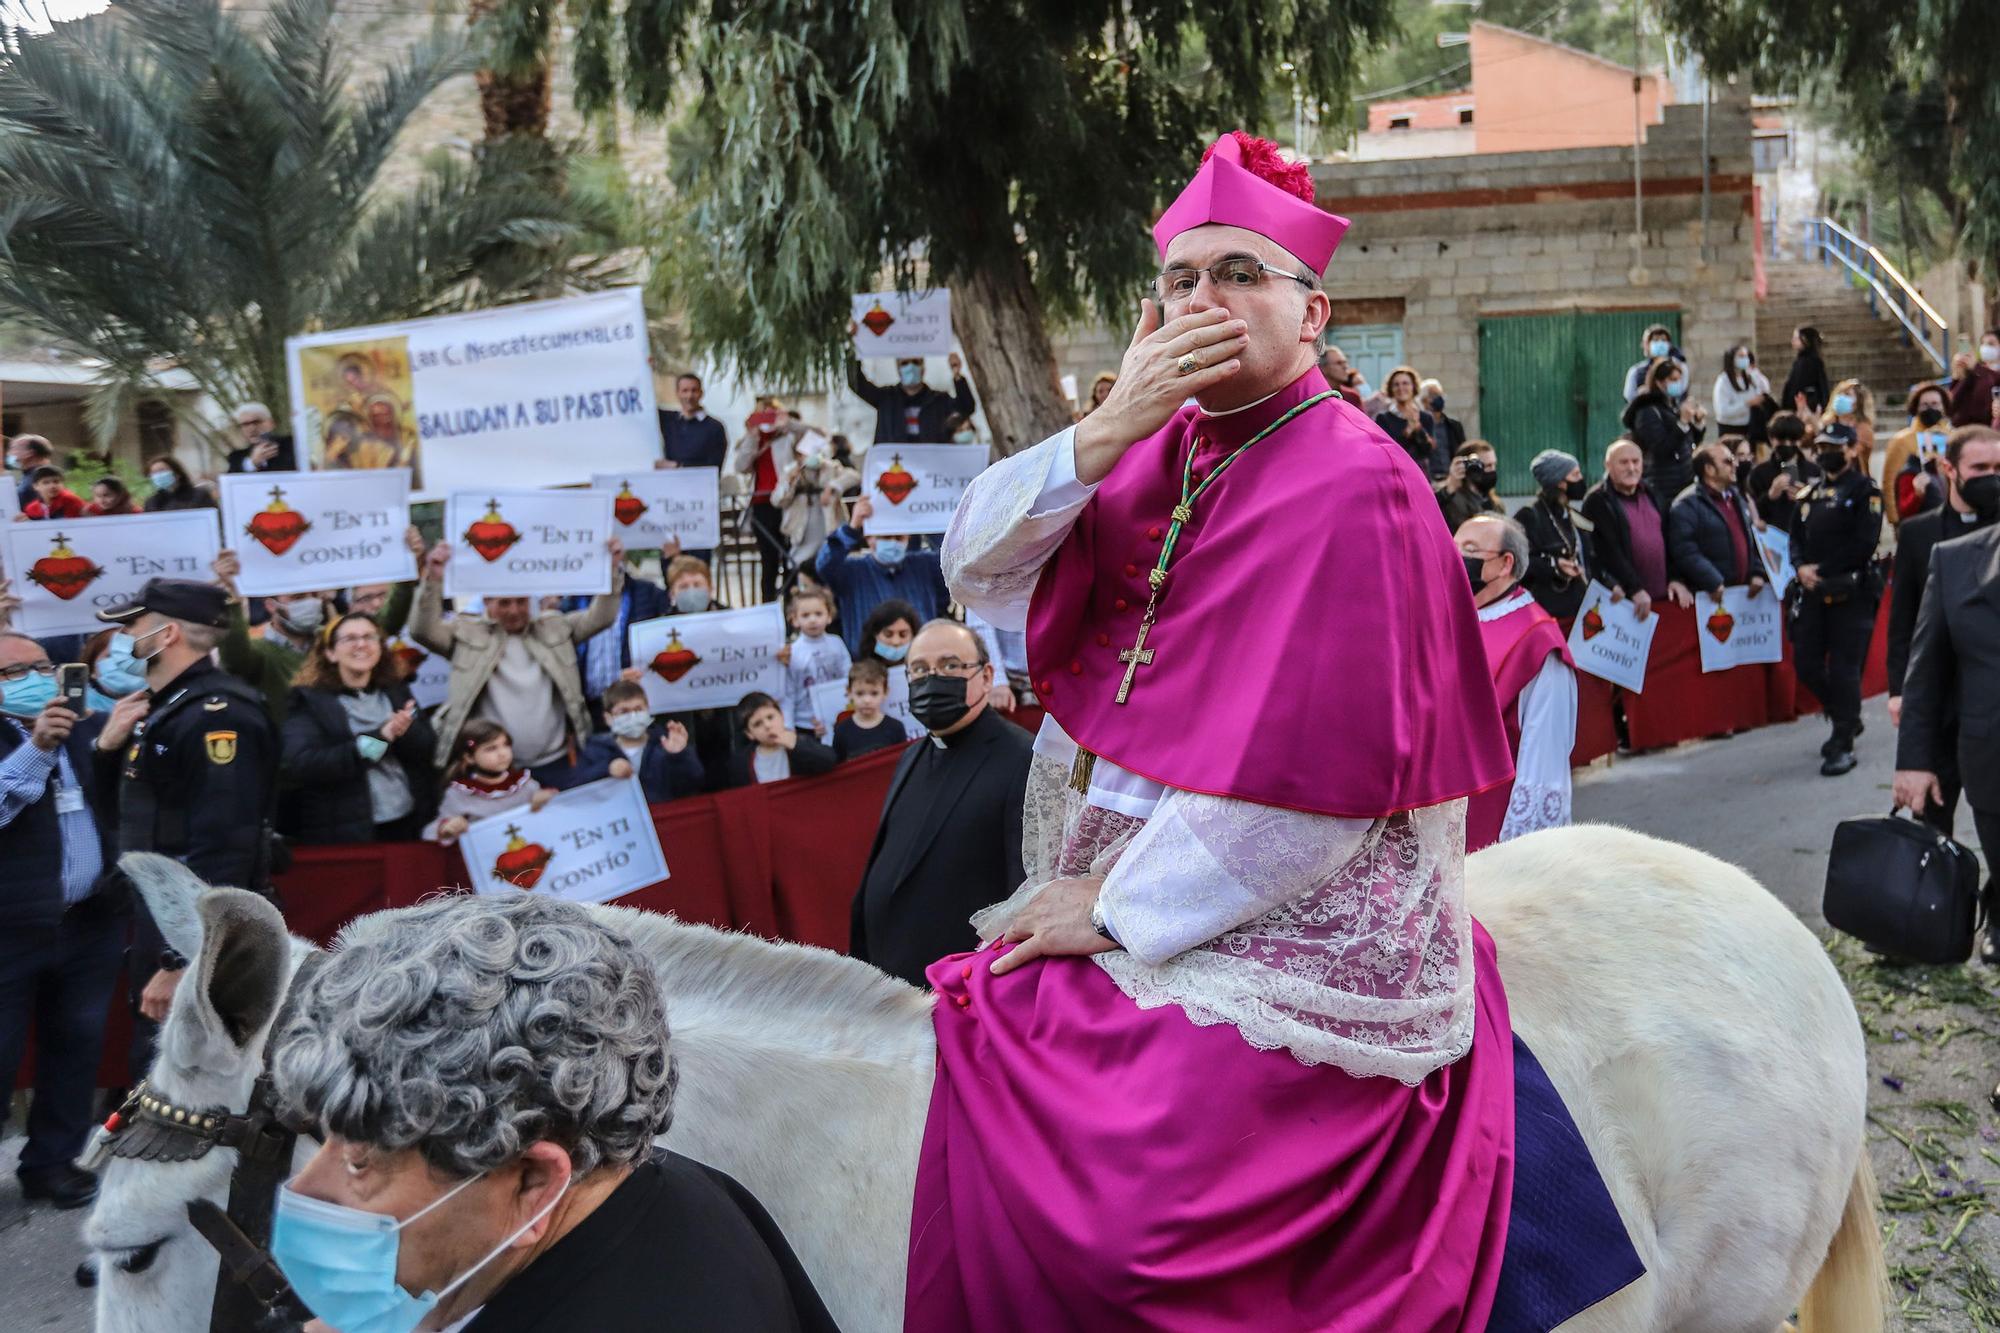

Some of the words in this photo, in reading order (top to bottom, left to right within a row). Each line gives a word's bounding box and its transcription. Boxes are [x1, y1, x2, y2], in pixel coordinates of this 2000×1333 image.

[419, 404, 511, 439] SALUDAN
[513, 403, 529, 429] A
[535, 395, 560, 425] SU
[563, 386, 643, 421] PASTOR
[689, 500, 704, 511] TI
[368, 511, 389, 526] TI
[575, 530, 593, 542] TI
[173, 557, 198, 570] TI
[752, 645, 767, 657] TI
[608, 816, 630, 836] TI
